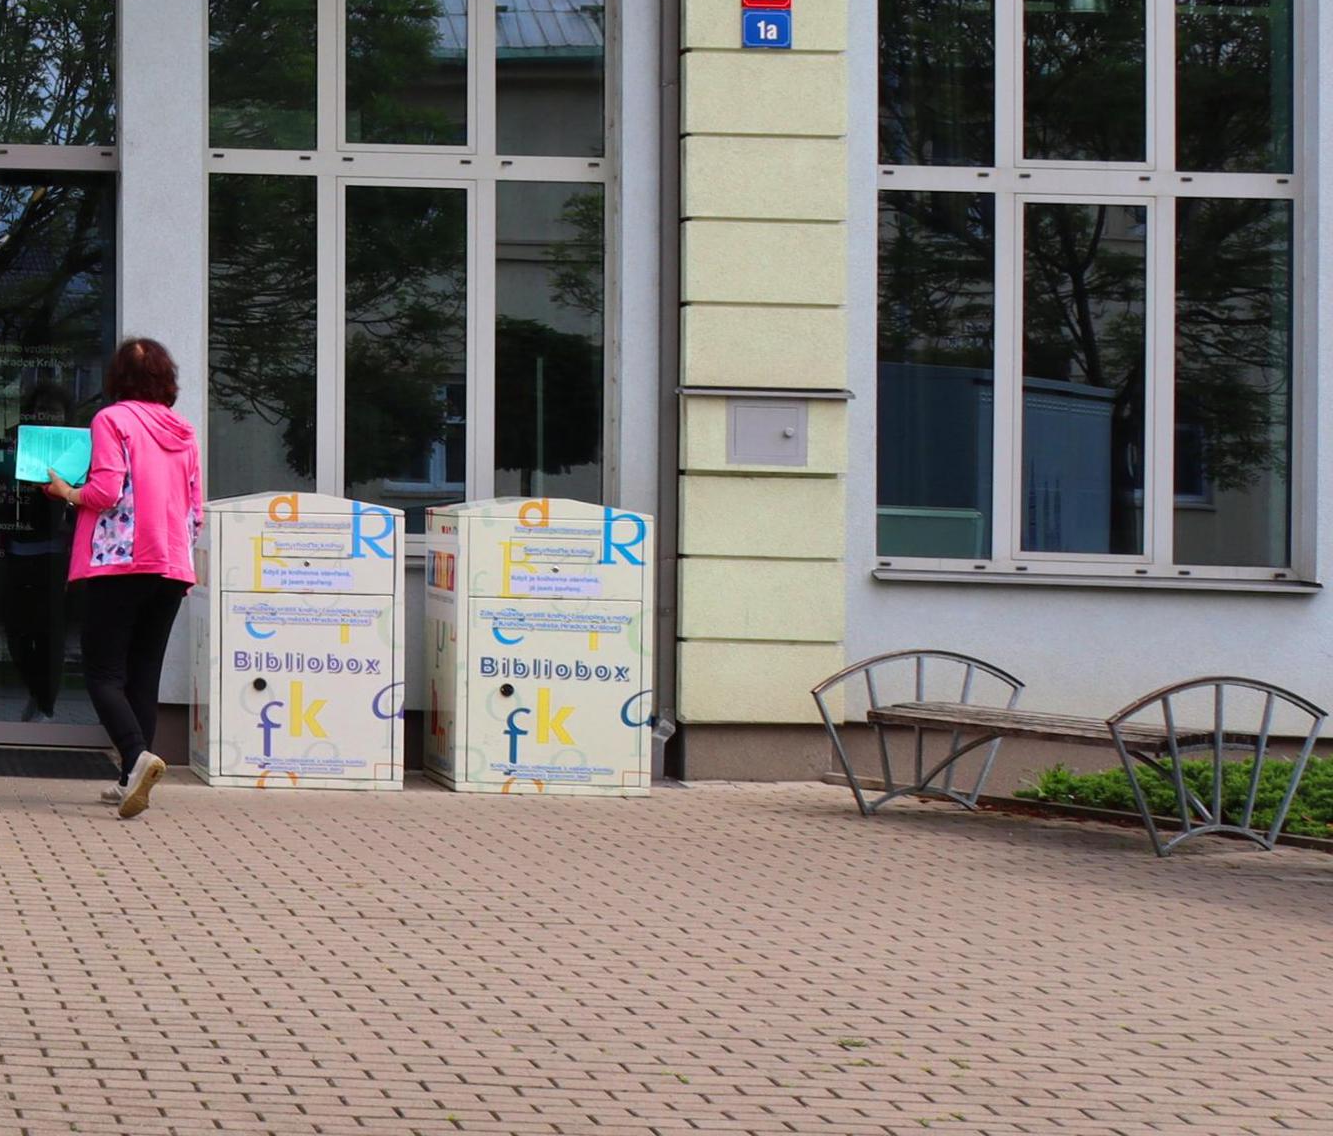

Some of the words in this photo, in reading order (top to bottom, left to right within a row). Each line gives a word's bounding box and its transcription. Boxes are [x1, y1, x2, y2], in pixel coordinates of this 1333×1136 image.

[757, 20, 778, 40] 1a
[233, 650, 381, 675] Bibliobox
[480, 656, 630, 681] Bibliobox
